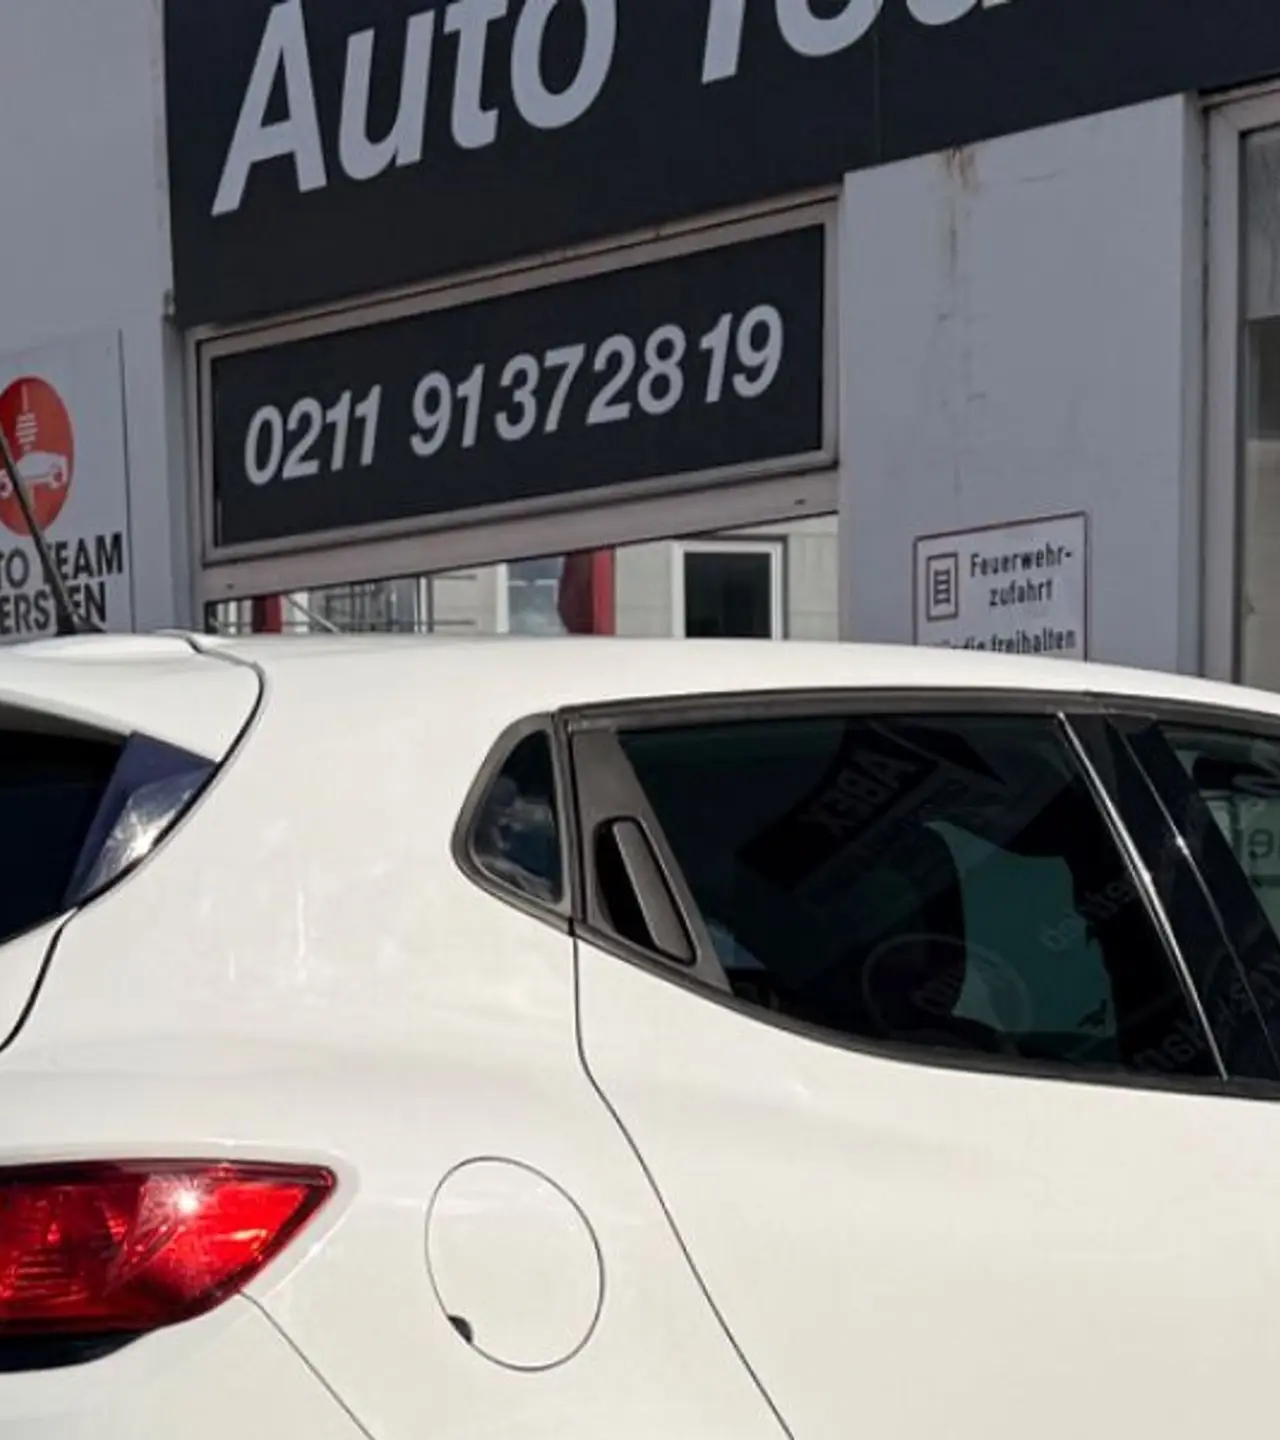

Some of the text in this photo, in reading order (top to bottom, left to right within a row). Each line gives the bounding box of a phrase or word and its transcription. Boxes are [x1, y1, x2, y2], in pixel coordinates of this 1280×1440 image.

[211, 0, 619, 217] Auto
[243, 303, 784, 486] 0211 91372819
[970, 541, 1073, 579] Feuerwehr-
[988, 577, 1054, 608] zufahrt
